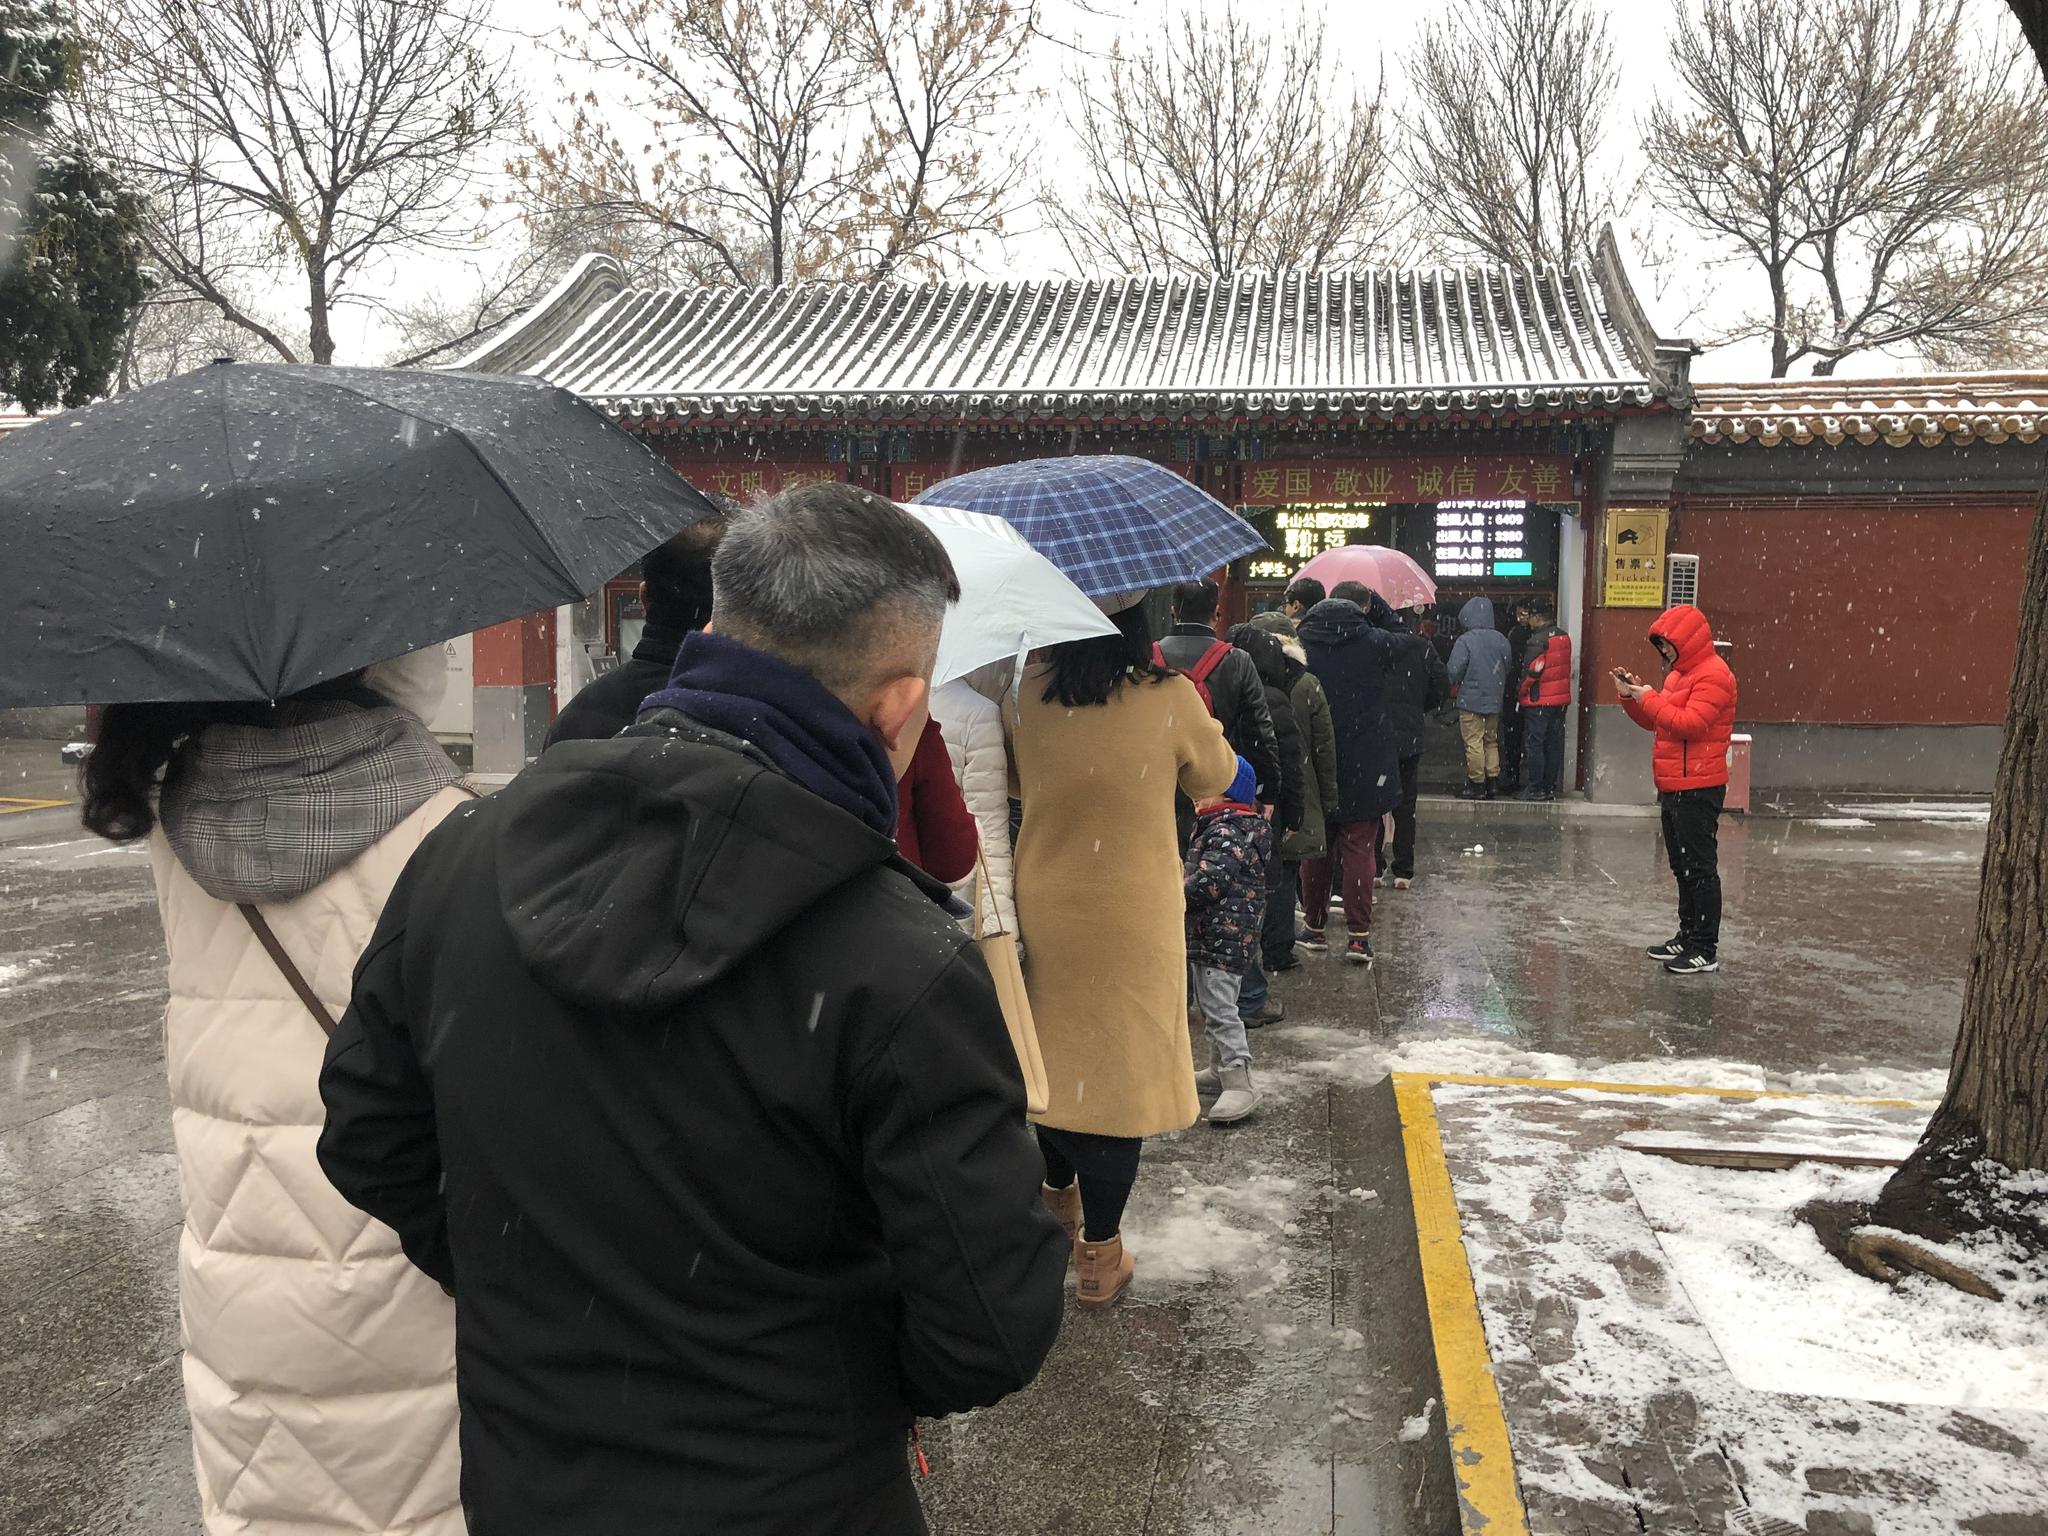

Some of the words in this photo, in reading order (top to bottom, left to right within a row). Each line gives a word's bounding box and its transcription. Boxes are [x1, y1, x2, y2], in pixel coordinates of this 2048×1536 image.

[712, 470, 764, 497] 文明
[1252, 467, 1312, 499] 爱国
[1332, 466, 1394, 497] 敬业
[1415, 465, 1477, 496] 诚信
[1497, 463, 1562, 495] 友善
[1615, 573, 1656, 582] Tickets
